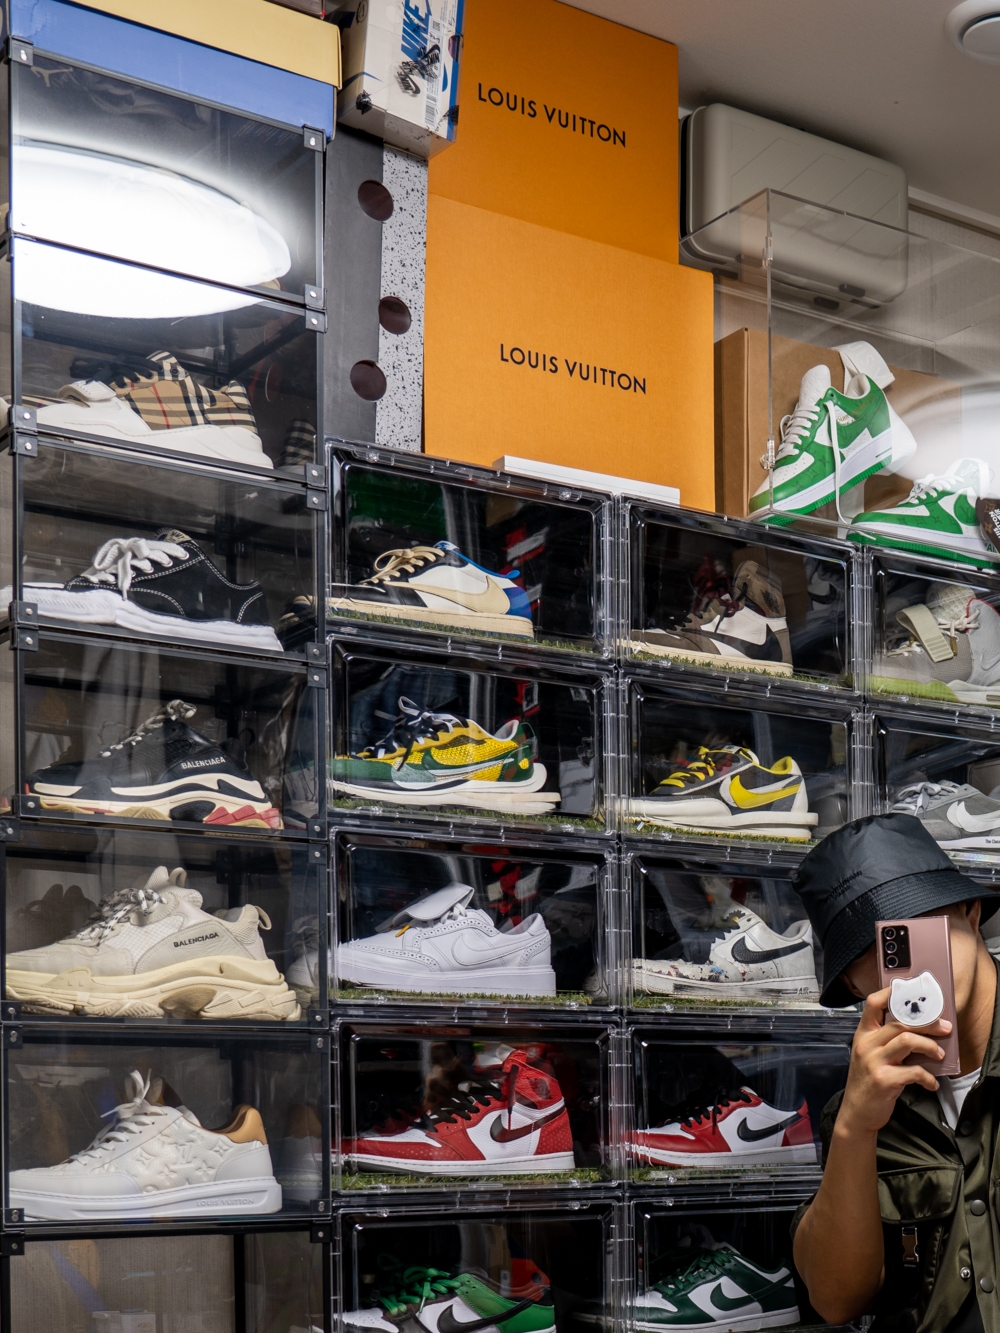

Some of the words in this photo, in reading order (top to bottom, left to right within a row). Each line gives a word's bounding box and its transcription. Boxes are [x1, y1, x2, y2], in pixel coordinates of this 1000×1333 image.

[401, 0, 430, 79] NIKE
[478, 82, 537, 118] LOUIS
[543, 104, 626, 148] VUITTON
[500, 343, 559, 374] LOUIS
[564, 359, 646, 395] VUITTON
[181, 756, 226, 770] BALENCIAGA
[173, 932, 220, 948] BALENCIAGA
[797, 987, 809, 995] AIR
[196, 1198, 219, 1207] LOUIS
[221, 1198, 254, 1207] VUITTON
